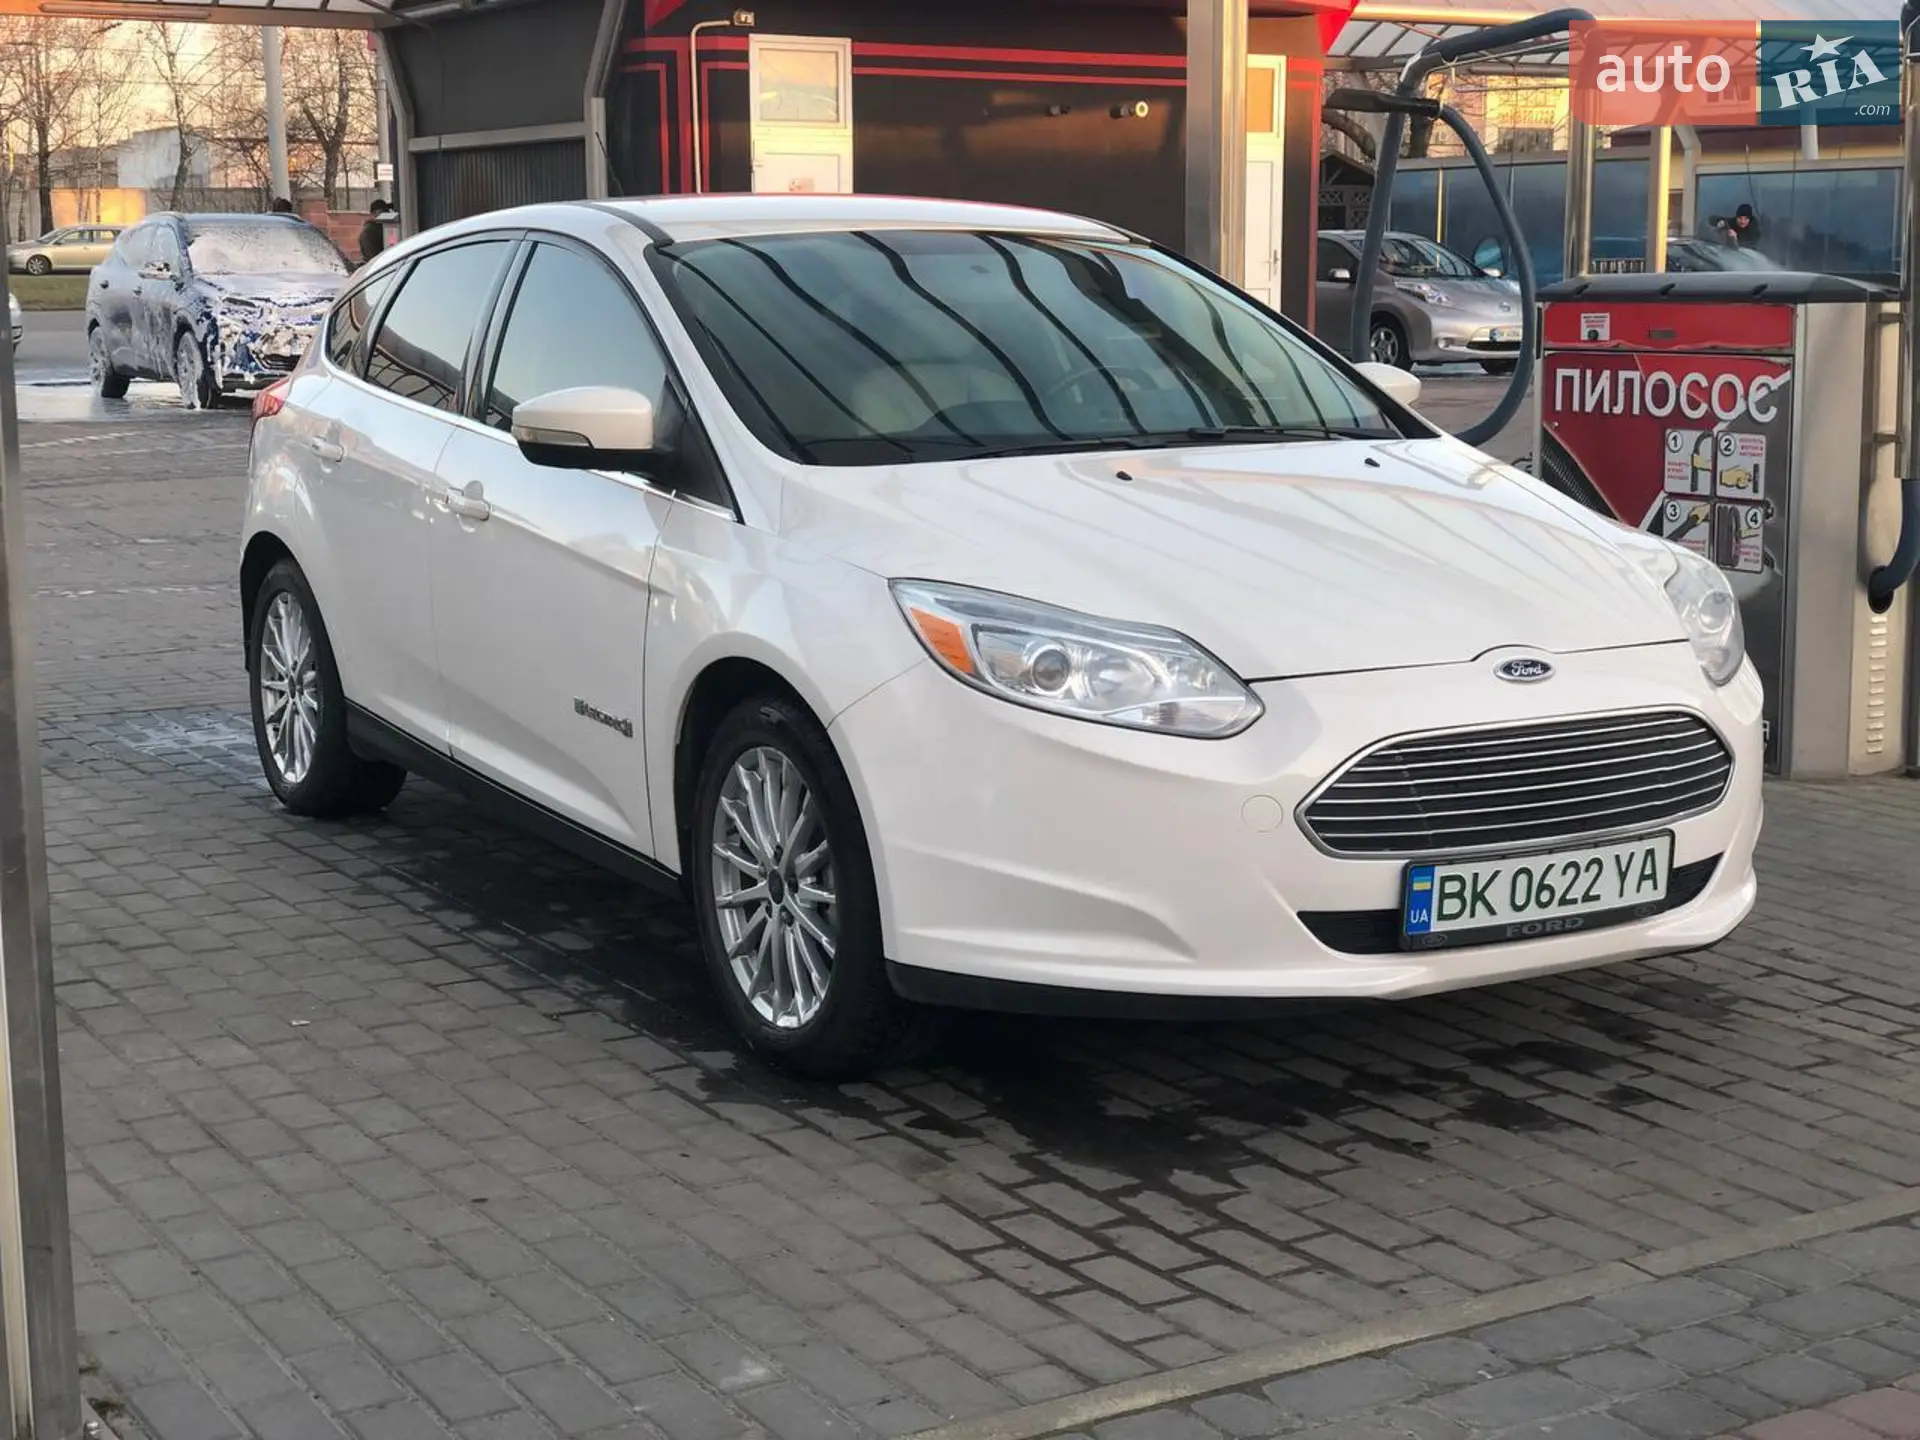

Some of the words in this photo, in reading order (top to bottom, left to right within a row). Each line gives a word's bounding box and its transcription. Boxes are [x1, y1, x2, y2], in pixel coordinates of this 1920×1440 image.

[1554, 367, 1778, 423] ПИЛОСОС
[1671, 434, 1679, 448] 1
[1723, 437, 1732, 452] 2
[1669, 503, 1678, 517] 3
[1749, 511, 1758, 526] 4
[1511, 660, 1544, 676] Ford
[1436, 869, 1502, 922] BK
[1509, 857, 1602, 913] 0622
[1614, 847, 1659, 898] YA
[1410, 908, 1429, 924] UA
[1506, 916, 1585, 938] FORD
